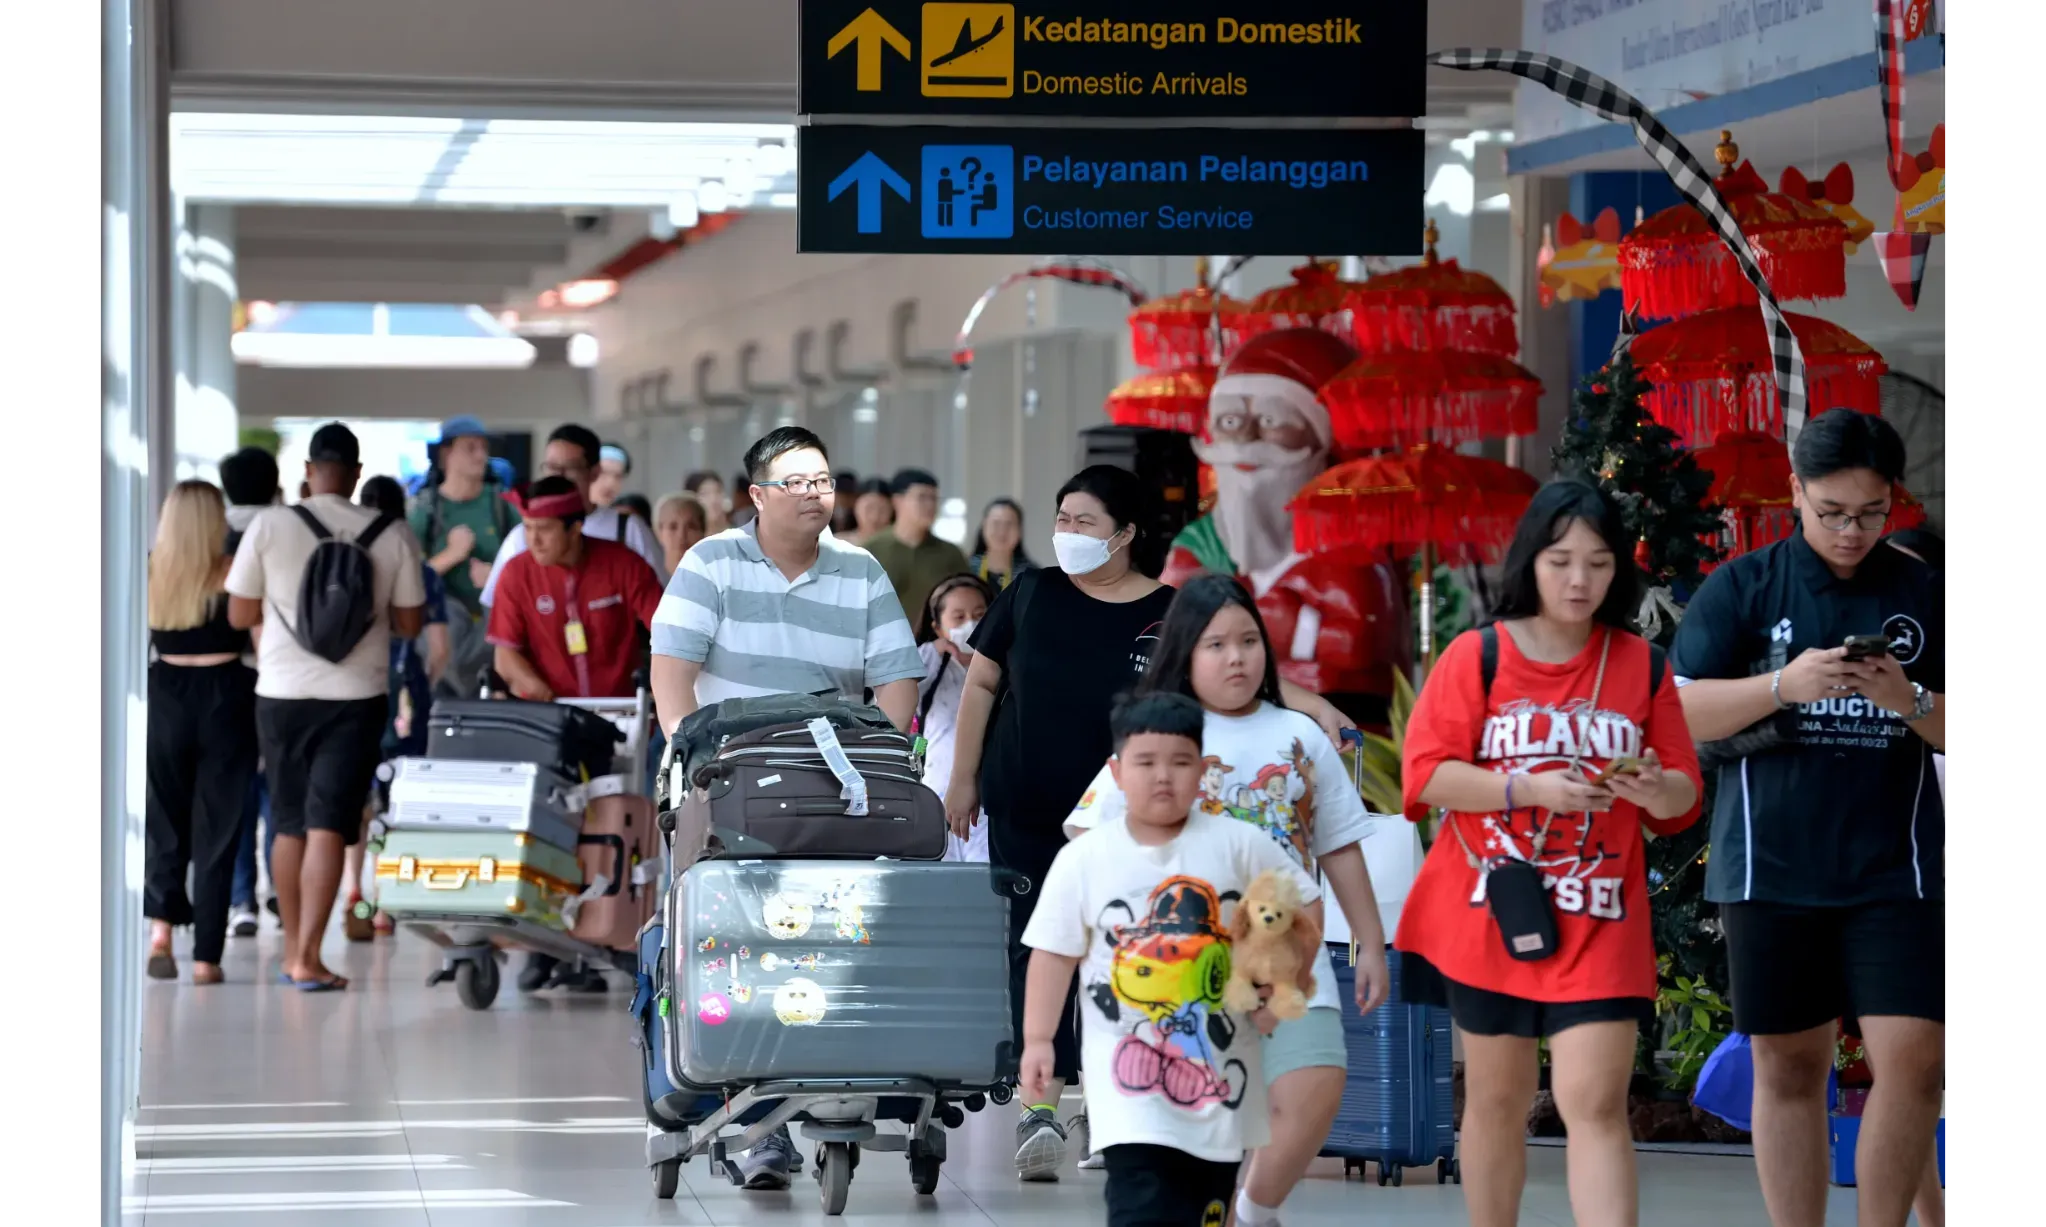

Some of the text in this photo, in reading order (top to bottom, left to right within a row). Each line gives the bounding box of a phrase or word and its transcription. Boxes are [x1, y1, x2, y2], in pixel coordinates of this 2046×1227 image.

[1023, 15, 1361, 50] Kedatangan Domestik
[1023, 70, 1247, 96] Domestic Arrivals
[1023, 155, 1367, 189] Pelayanan Pelanggan
[1023, 205, 1253, 230] Customer Service
[1134, 663, 1144, 673] IN
